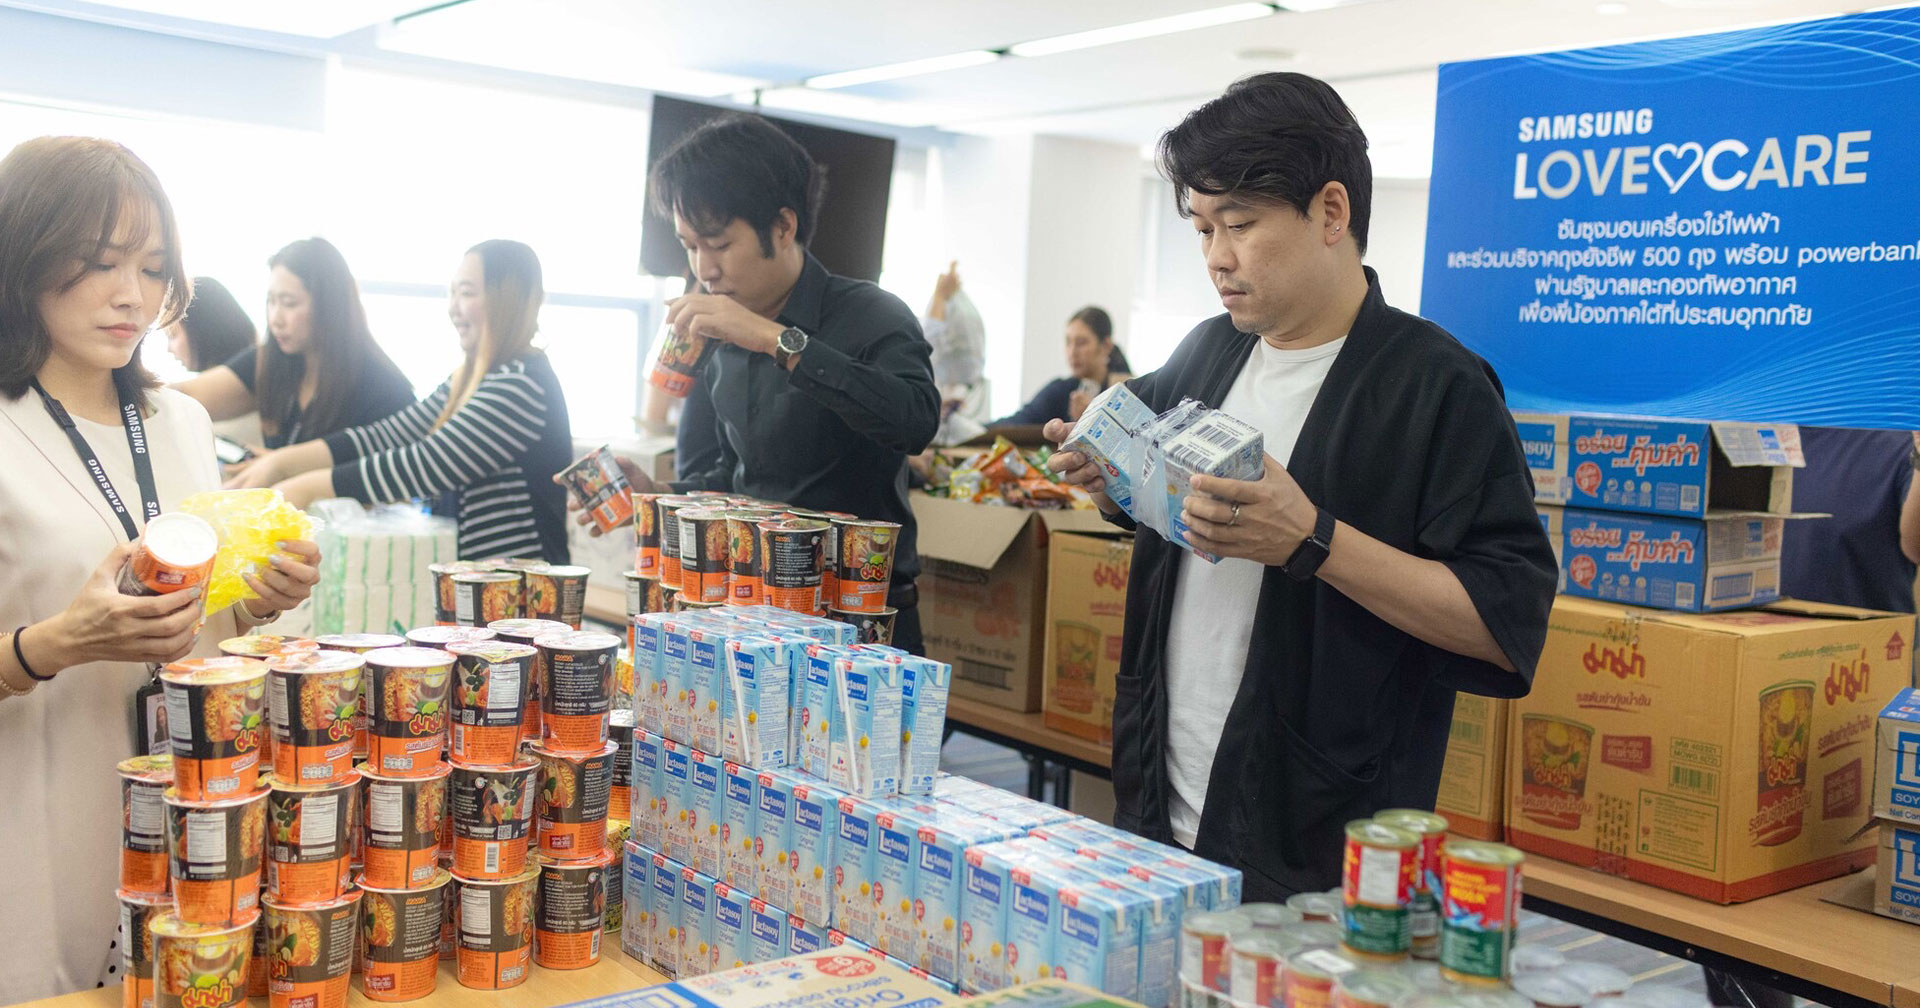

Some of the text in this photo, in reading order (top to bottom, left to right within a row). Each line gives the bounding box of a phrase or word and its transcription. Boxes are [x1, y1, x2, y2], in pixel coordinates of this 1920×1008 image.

[1518, 108, 1653, 142] SAMSUNG
[1513, 130, 1872, 200] LOVE CARE
[1557, 212, 1780, 243] ซัมซุงมอบเครื่องใช้ไฟฟ้า
[1642, 246, 1681, 267] 500
[1688, 247, 1717, 270] ถุง
[1724, 243, 1788, 265] พร้อม
[1535, 274, 1797, 301] ผ่านรัฐบาลและกองทัพอากาศ
[124, 403, 146, 454] SAMSUNG
[88, 459, 125, 513] SAMSUNG
[879, 830, 909, 856] Lactasoy
[921, 845, 951, 873] Lactasoy
[716, 898, 741, 922] Lactasoy
[752, 913, 779, 938] Lactasoy
